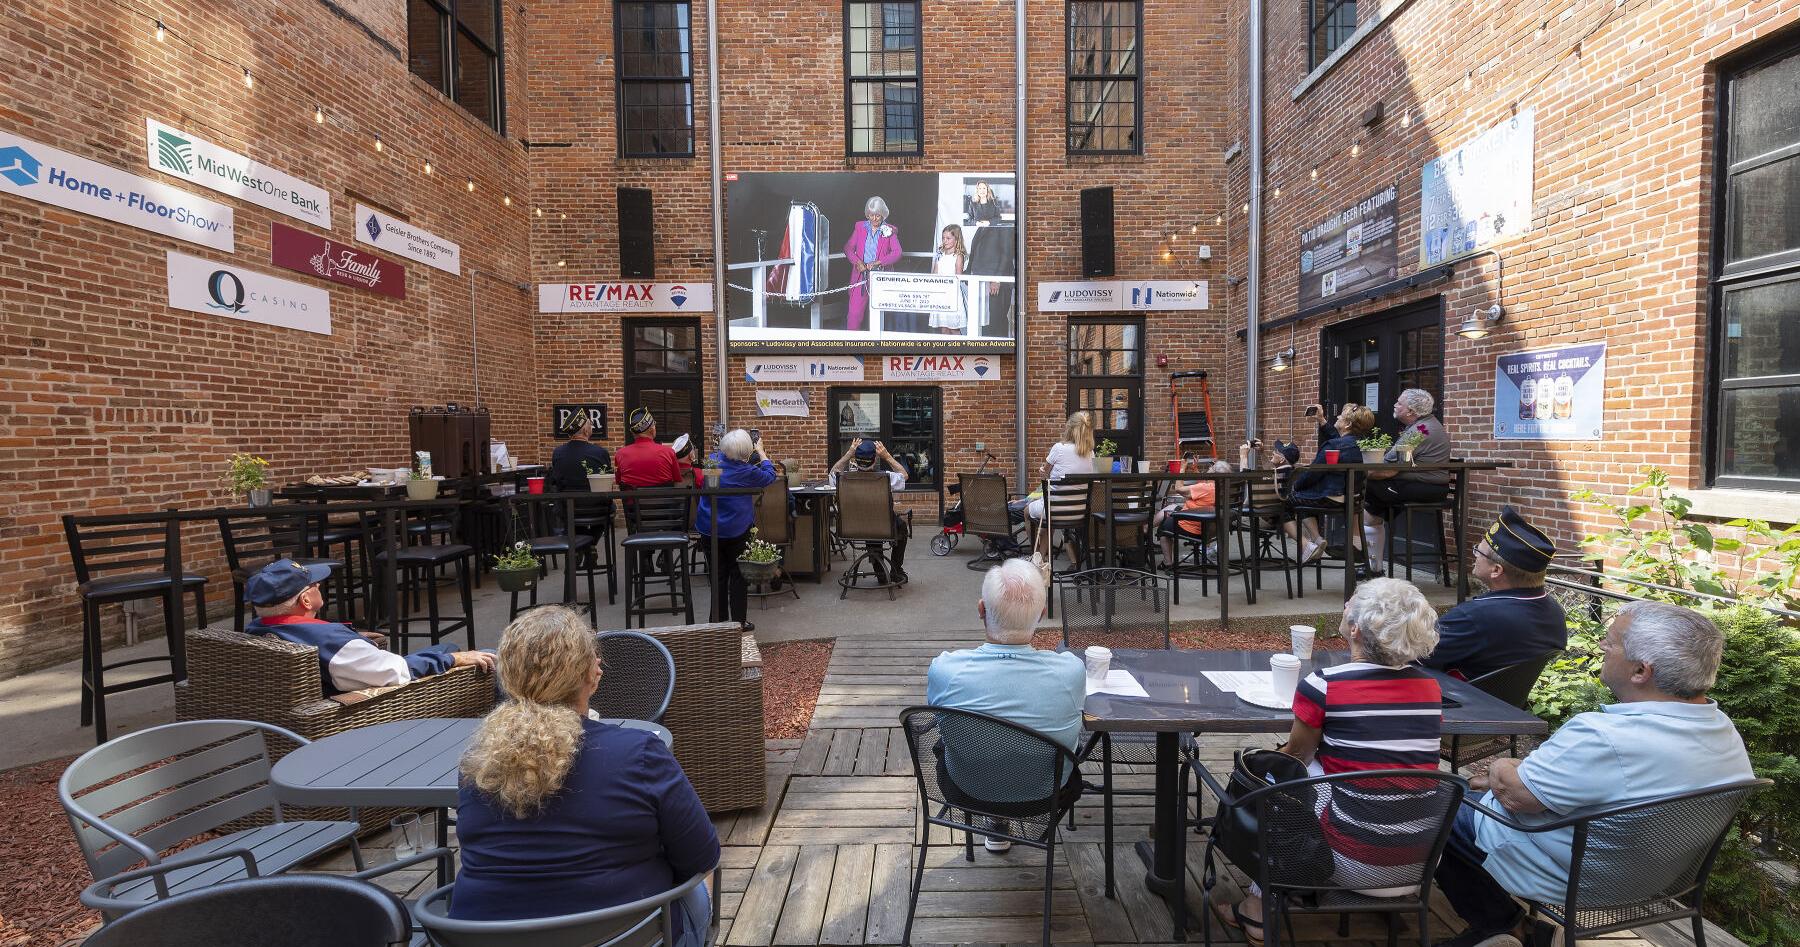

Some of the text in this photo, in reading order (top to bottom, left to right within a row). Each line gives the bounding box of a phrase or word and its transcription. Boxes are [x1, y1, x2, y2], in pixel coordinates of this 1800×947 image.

[198, 154, 320, 213] MidWestOne Bank
[48, 167, 219, 232] Home + FloorShow
[1301, 228, 1316, 246] PATIO
[1317, 215, 1341, 237] DRAUGHT
[1343, 206, 1358, 224] BEER
[1426, 214, 1436, 231] 12
[385, 223, 454, 257] Geisler Brothers Company
[408, 243, 436, 260] Since 1892
[338, 250, 381, 287] Family
[208, 270, 245, 313] Q
[569, 285, 654, 300] RE/MAX
[1065, 289, 1113, 297] LUDOVISSY
[1155, 290, 1197, 298] Nationwide
[250, 292, 308, 311] CASINO
[570, 300, 655, 308] ADVANTAGE REALTY
[766, 340, 796, 348] Ludovissy
[890, 356, 965, 370] RE/MAX
[1507, 364, 1519, 374] REAL
[1543, 360, 1557, 371] REAL
[771, 398, 805, 406] McGrath
